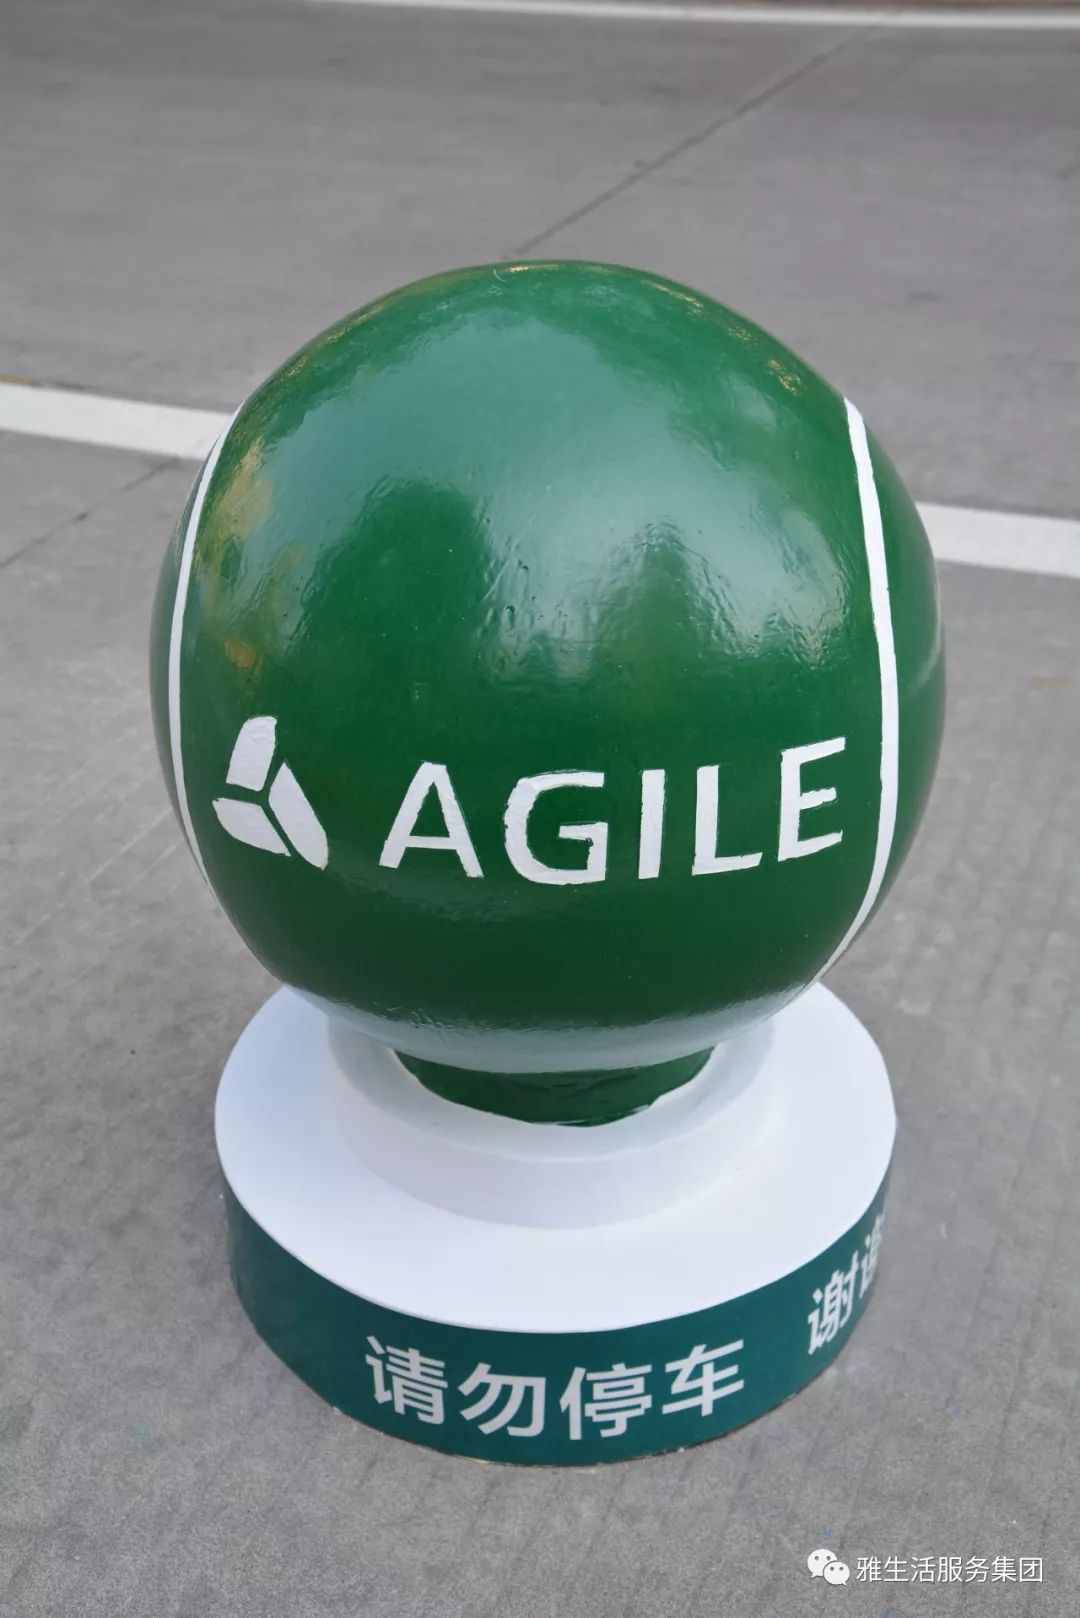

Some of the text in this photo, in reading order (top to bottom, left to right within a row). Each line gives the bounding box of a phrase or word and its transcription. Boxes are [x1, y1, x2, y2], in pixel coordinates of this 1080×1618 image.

[379, 736, 846, 885] AGILE
[365, 1335, 745, 1441] 请勿停车
